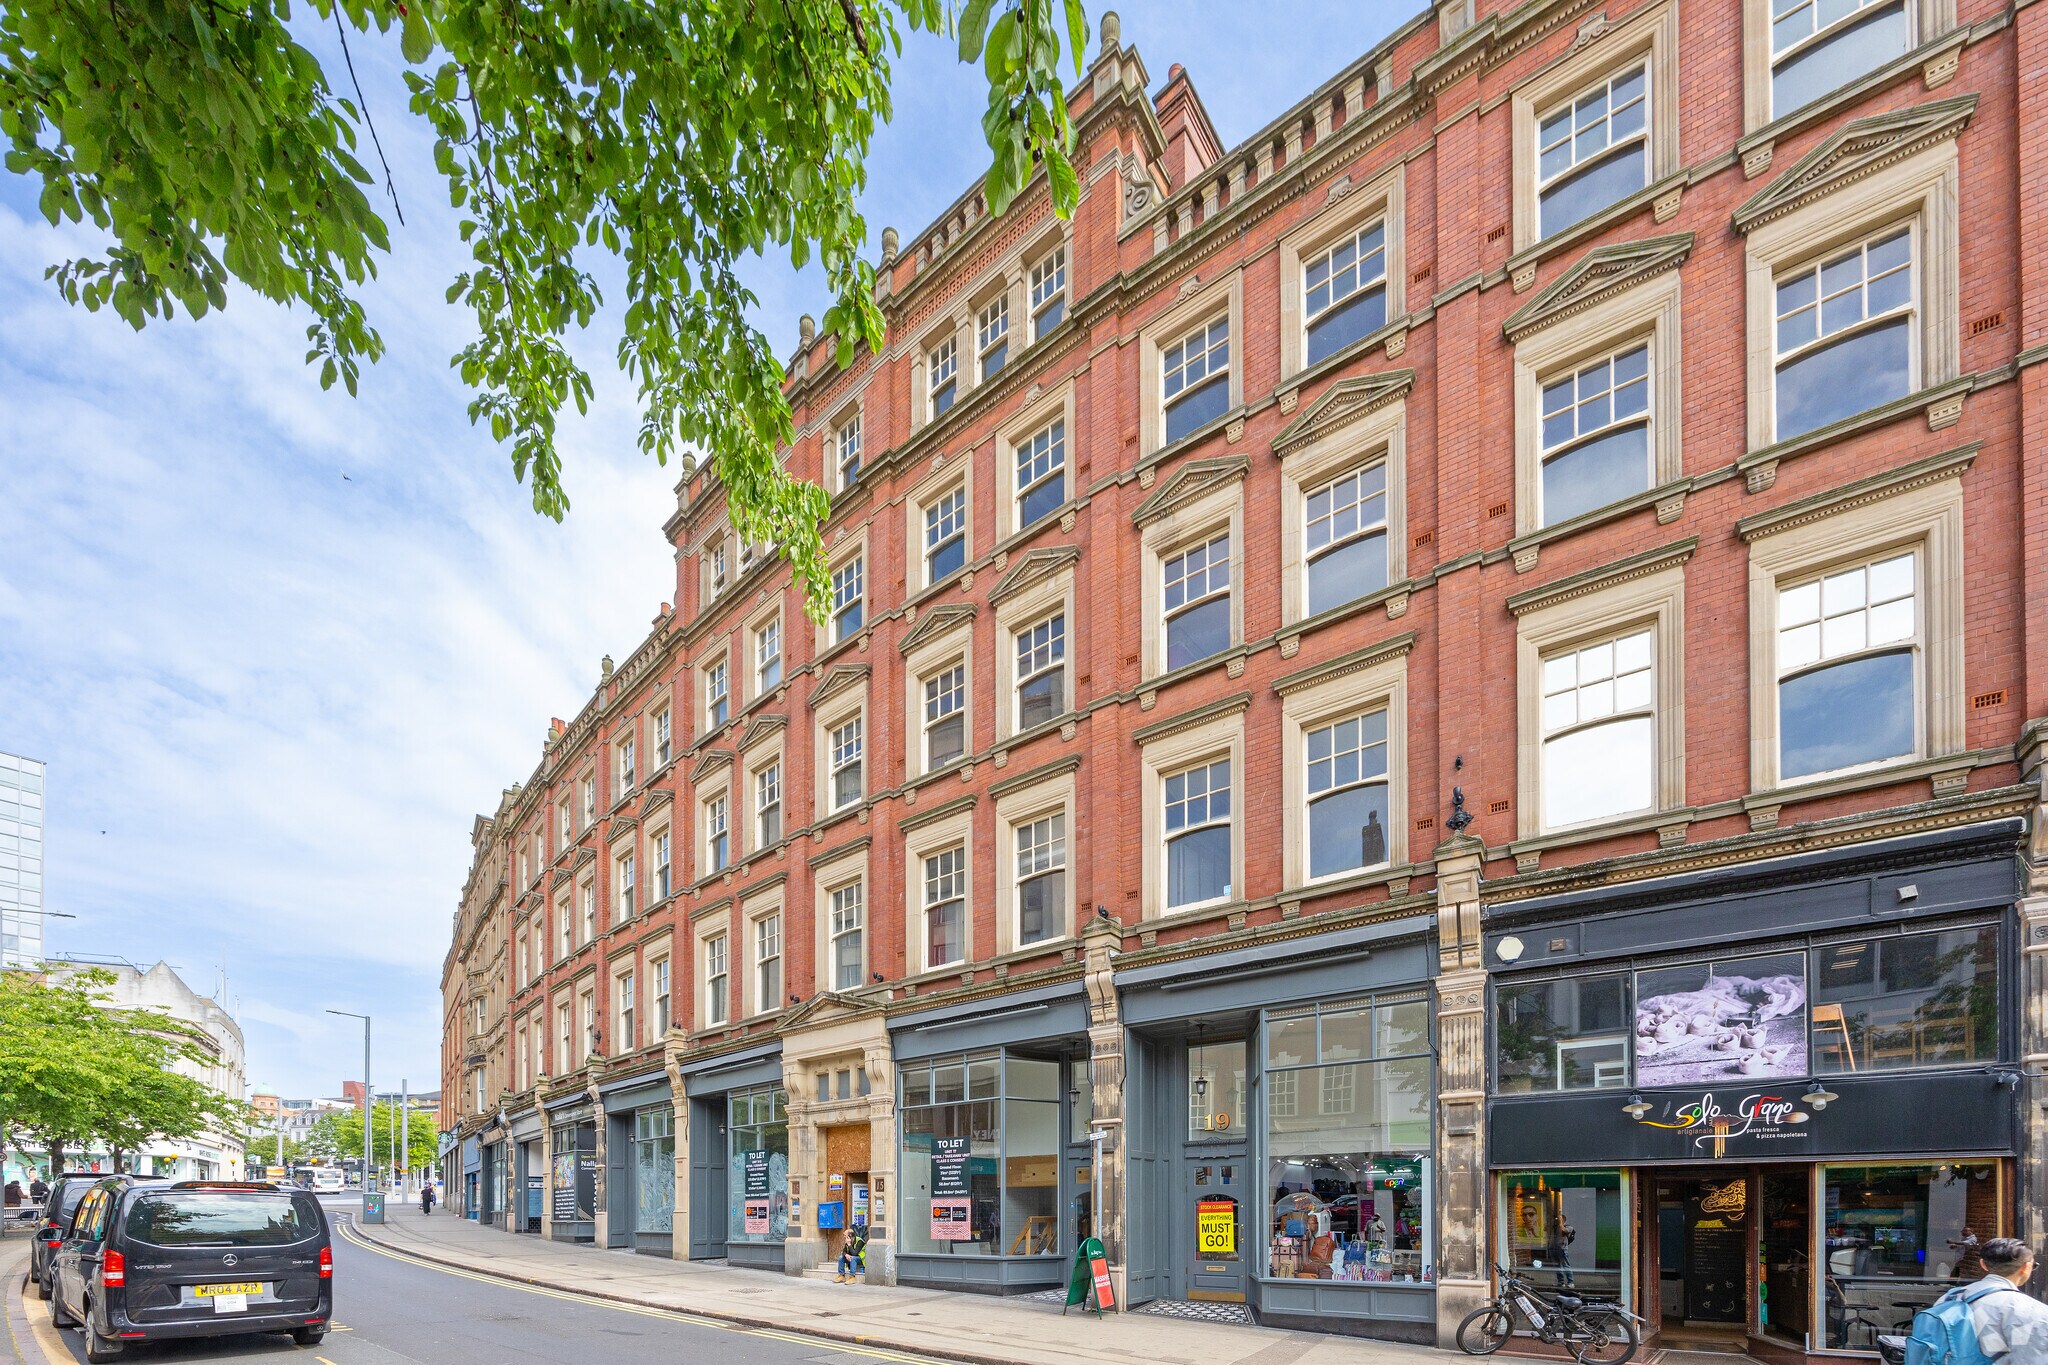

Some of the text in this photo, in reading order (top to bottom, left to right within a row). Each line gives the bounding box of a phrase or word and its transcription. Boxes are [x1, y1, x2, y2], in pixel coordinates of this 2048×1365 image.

[1657, 1093, 1794, 1128] Solo Grano
[1204, 1112, 1231, 1131] 19
[1677, 1128, 1713, 1136] artigianale
[937, 1140, 948, 1148] TO
[950, 1139, 964, 1148] LET
[749, 1151, 765, 1160] TO LET
[1201, 1222, 1231, 1234] MUST
[1205, 1234, 1229, 1247] GO!
[200, 1283, 258, 1295] MR04 AZR
